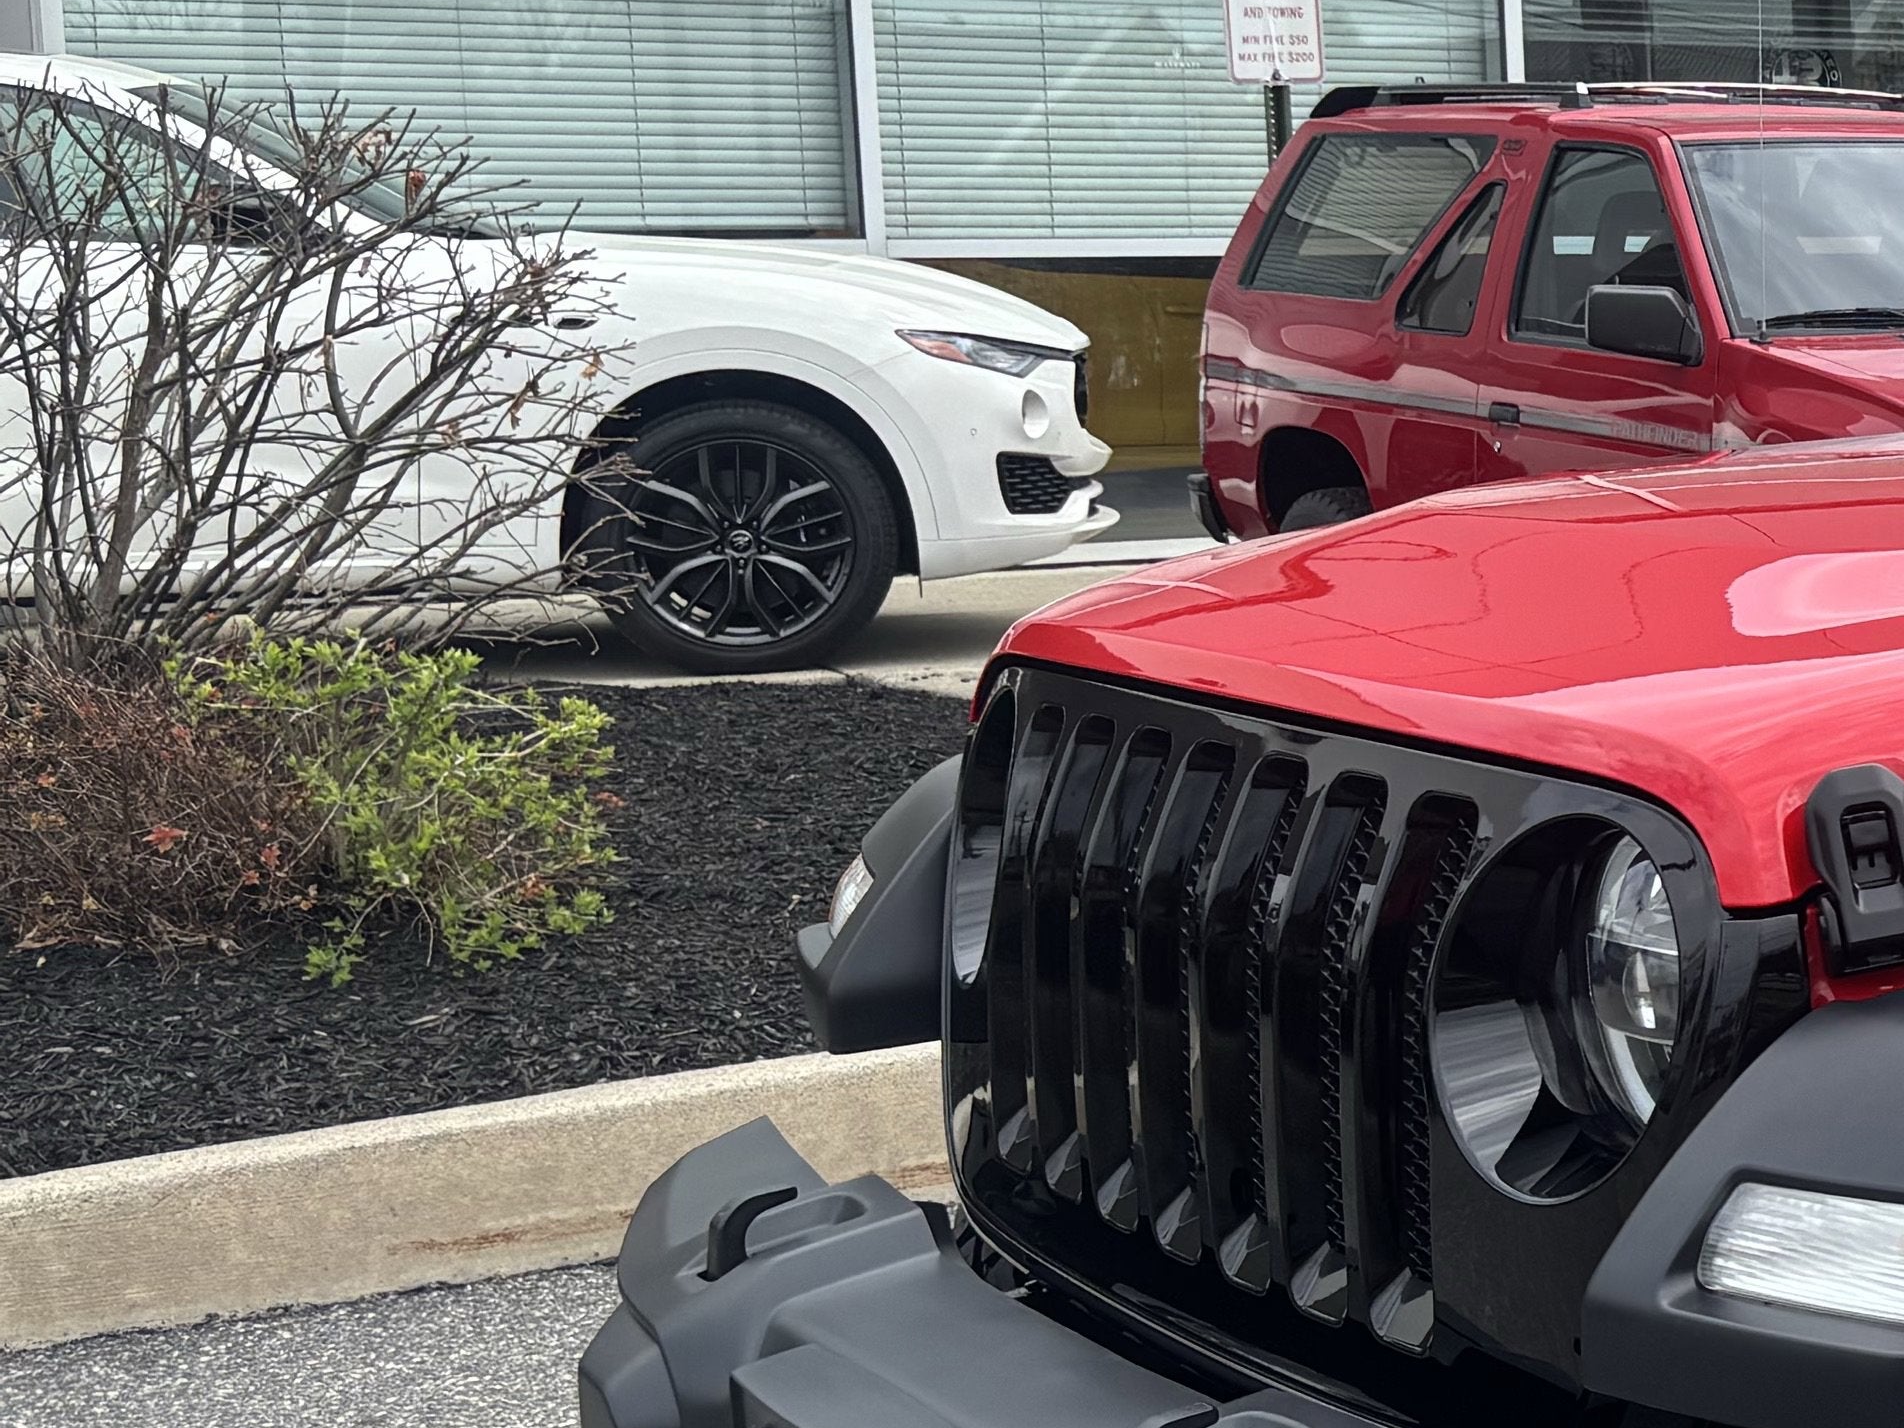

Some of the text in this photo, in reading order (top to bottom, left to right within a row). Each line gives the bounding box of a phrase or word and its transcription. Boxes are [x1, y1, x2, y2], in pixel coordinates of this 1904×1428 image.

[1243, 6, 1264, 18] AND
[1242, 35, 1260, 45] MIN
[1238, 52, 1258, 62] MAX
[1288, 51, 1315, 63] $200
